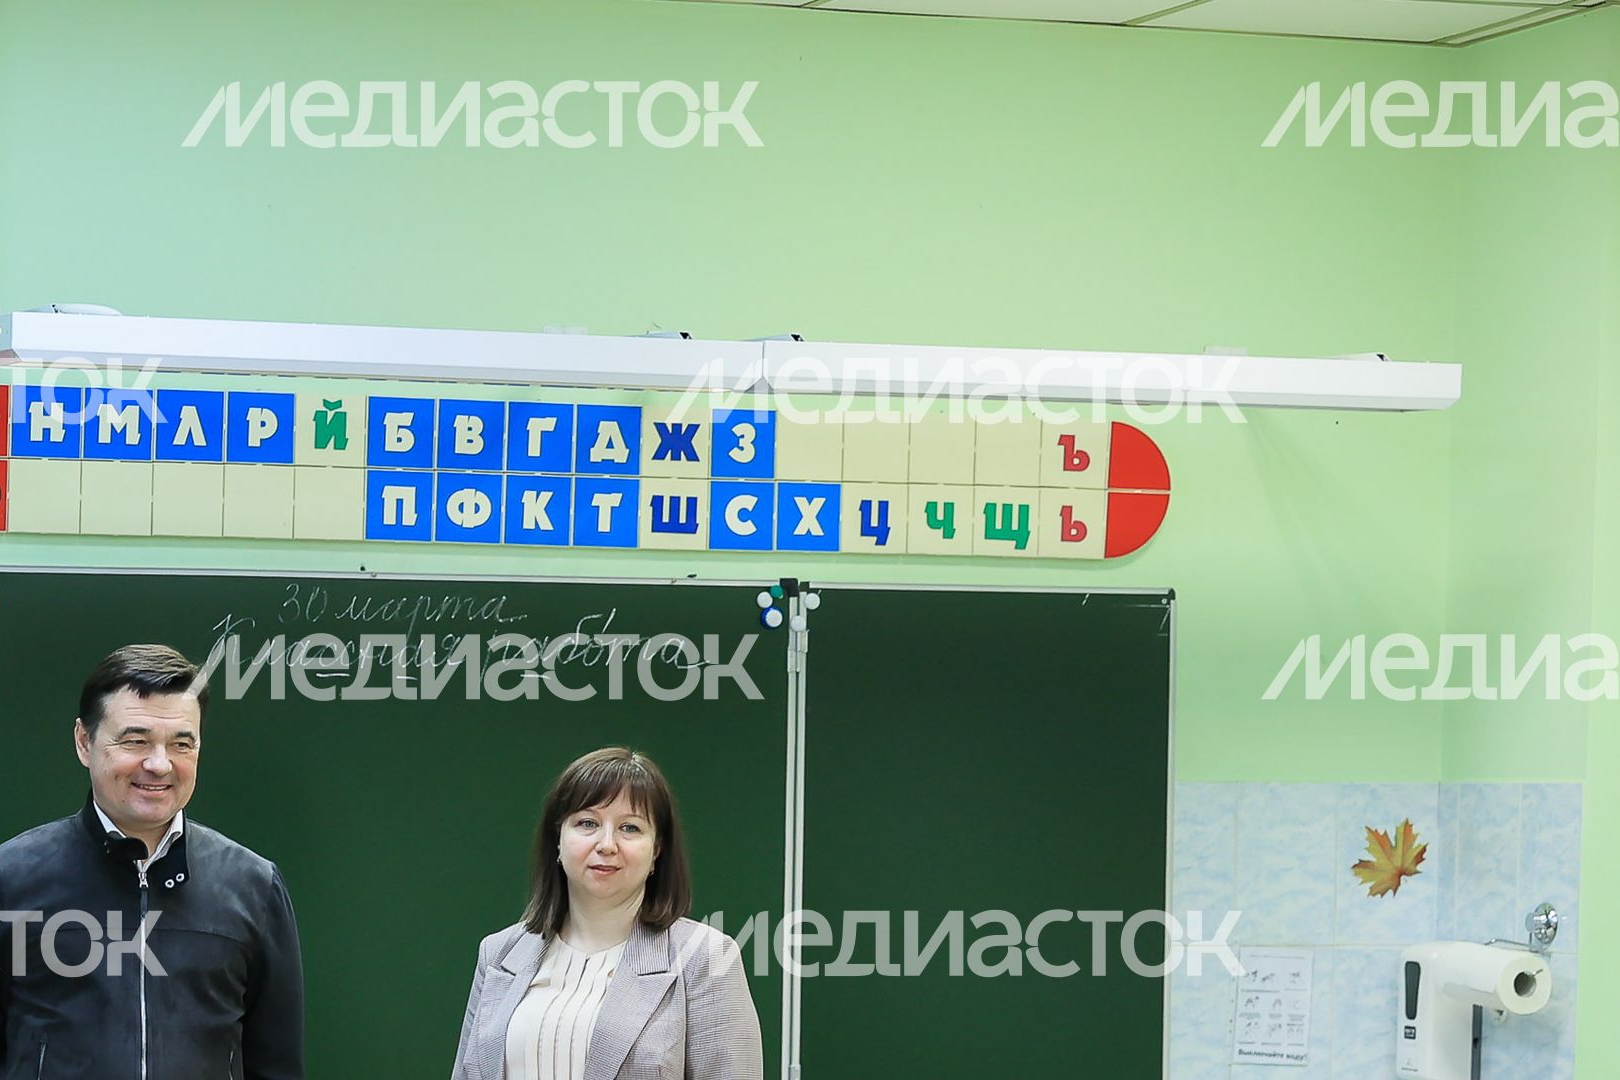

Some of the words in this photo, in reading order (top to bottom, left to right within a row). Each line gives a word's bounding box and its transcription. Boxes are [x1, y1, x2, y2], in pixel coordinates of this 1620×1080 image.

[29, 402, 66, 444] Н
[98, 403, 141, 446] М
[172, 405, 207, 448] Л
[246, 407, 279, 448] Р
[313, 399, 349, 451] Й
[383, 412, 416, 452] Б
[452, 414, 484, 455] В
[526, 416, 557, 457] Г
[589, 421, 631, 464] Д
[653, 423, 701, 462] Ж
[728, 423, 756, 464] З
[1057, 434, 1091, 472] Ъ
[382, 485, 418, 527] П
[446, 488, 492, 529] Ф
[521, 490, 554, 531] К
[591, 492, 624, 534] Т
[650, 495, 700, 534] Ш
[724, 495, 759, 537] С
[793, 497, 826, 537] Х
[860, 500, 891, 546] Ц
[924, 501, 956, 539] Ч
[984, 502, 1031, 549] Щ
[1060, 505, 1088, 543] Ь
[278, 582, 329, 624] 30
[335, 594, 527, 642] марта
